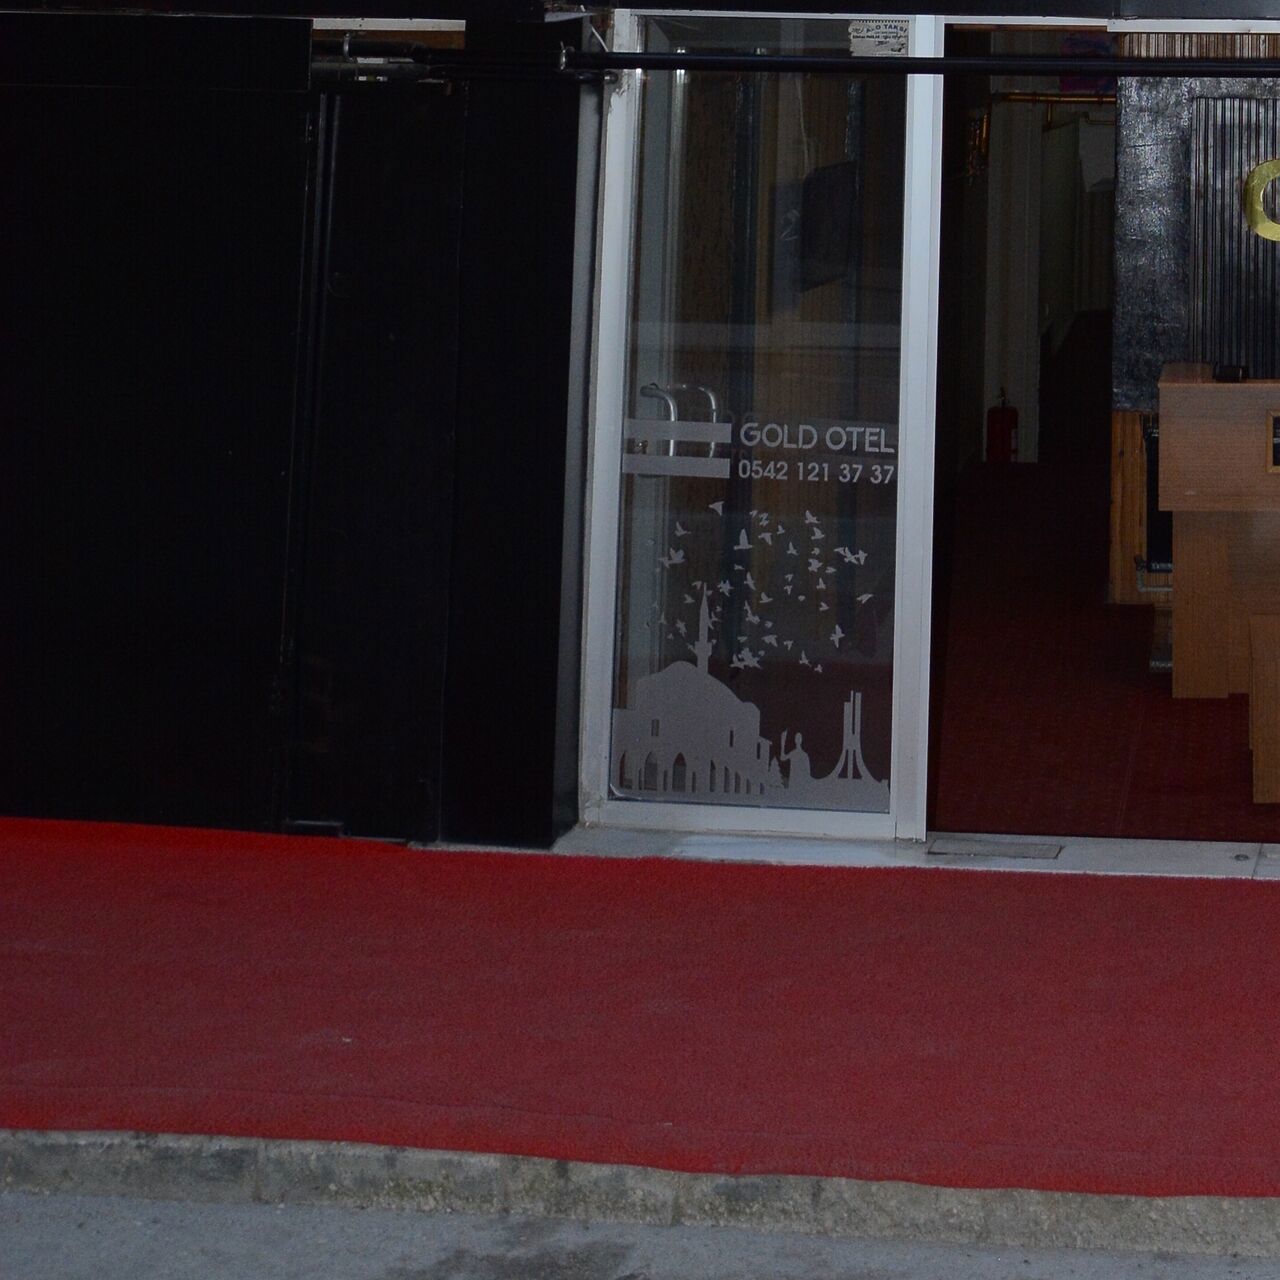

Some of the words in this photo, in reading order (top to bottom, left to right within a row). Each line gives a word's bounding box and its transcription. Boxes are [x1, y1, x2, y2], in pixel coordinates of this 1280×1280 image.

[739, 422, 818, 450] GOLD
[825, 426, 895, 453] OTEL
[738, 459, 789, 481] 0542
[797, 462, 829, 482] 121
[838, 463, 863, 483] 37
[870, 464, 895, 484] 37
